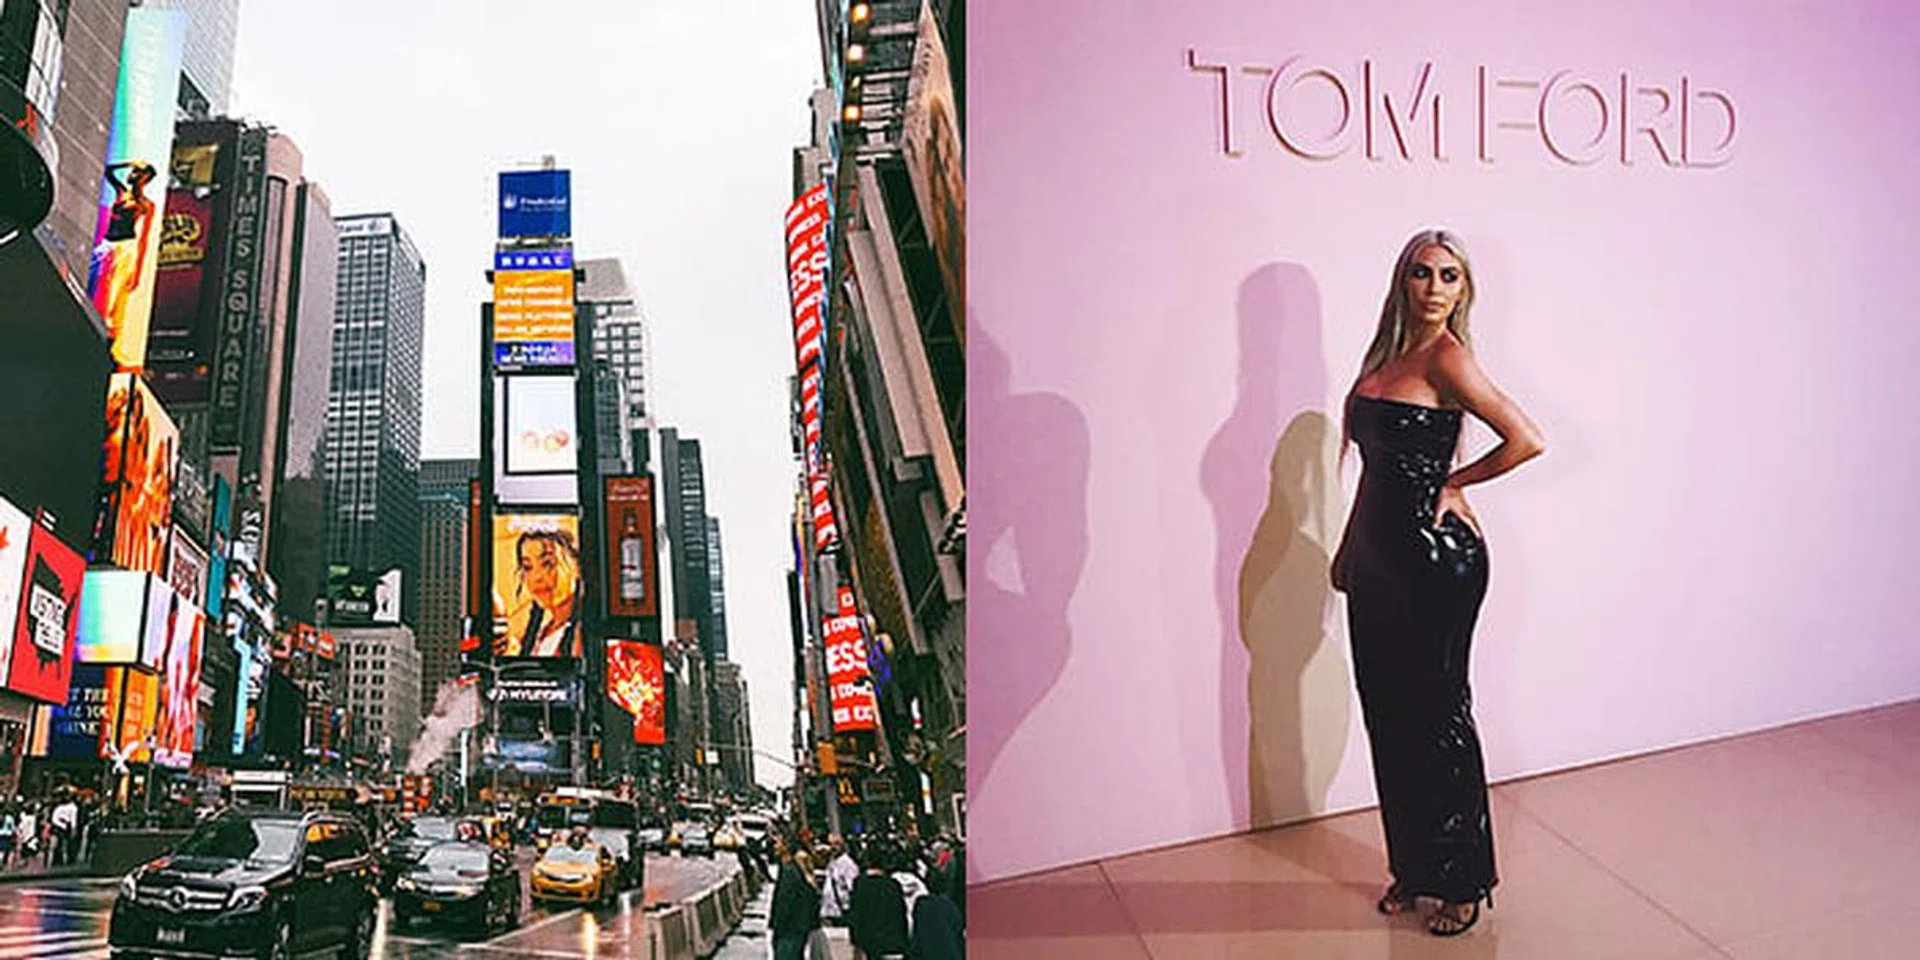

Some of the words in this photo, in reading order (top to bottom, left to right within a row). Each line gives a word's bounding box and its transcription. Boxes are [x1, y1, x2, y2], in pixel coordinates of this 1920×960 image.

[1182, 48, 1449, 162] TOM
[1476, 64, 1738, 169] FORD
[236, 154, 261, 257] TIMES
[219, 270, 248, 408] SQUARE
